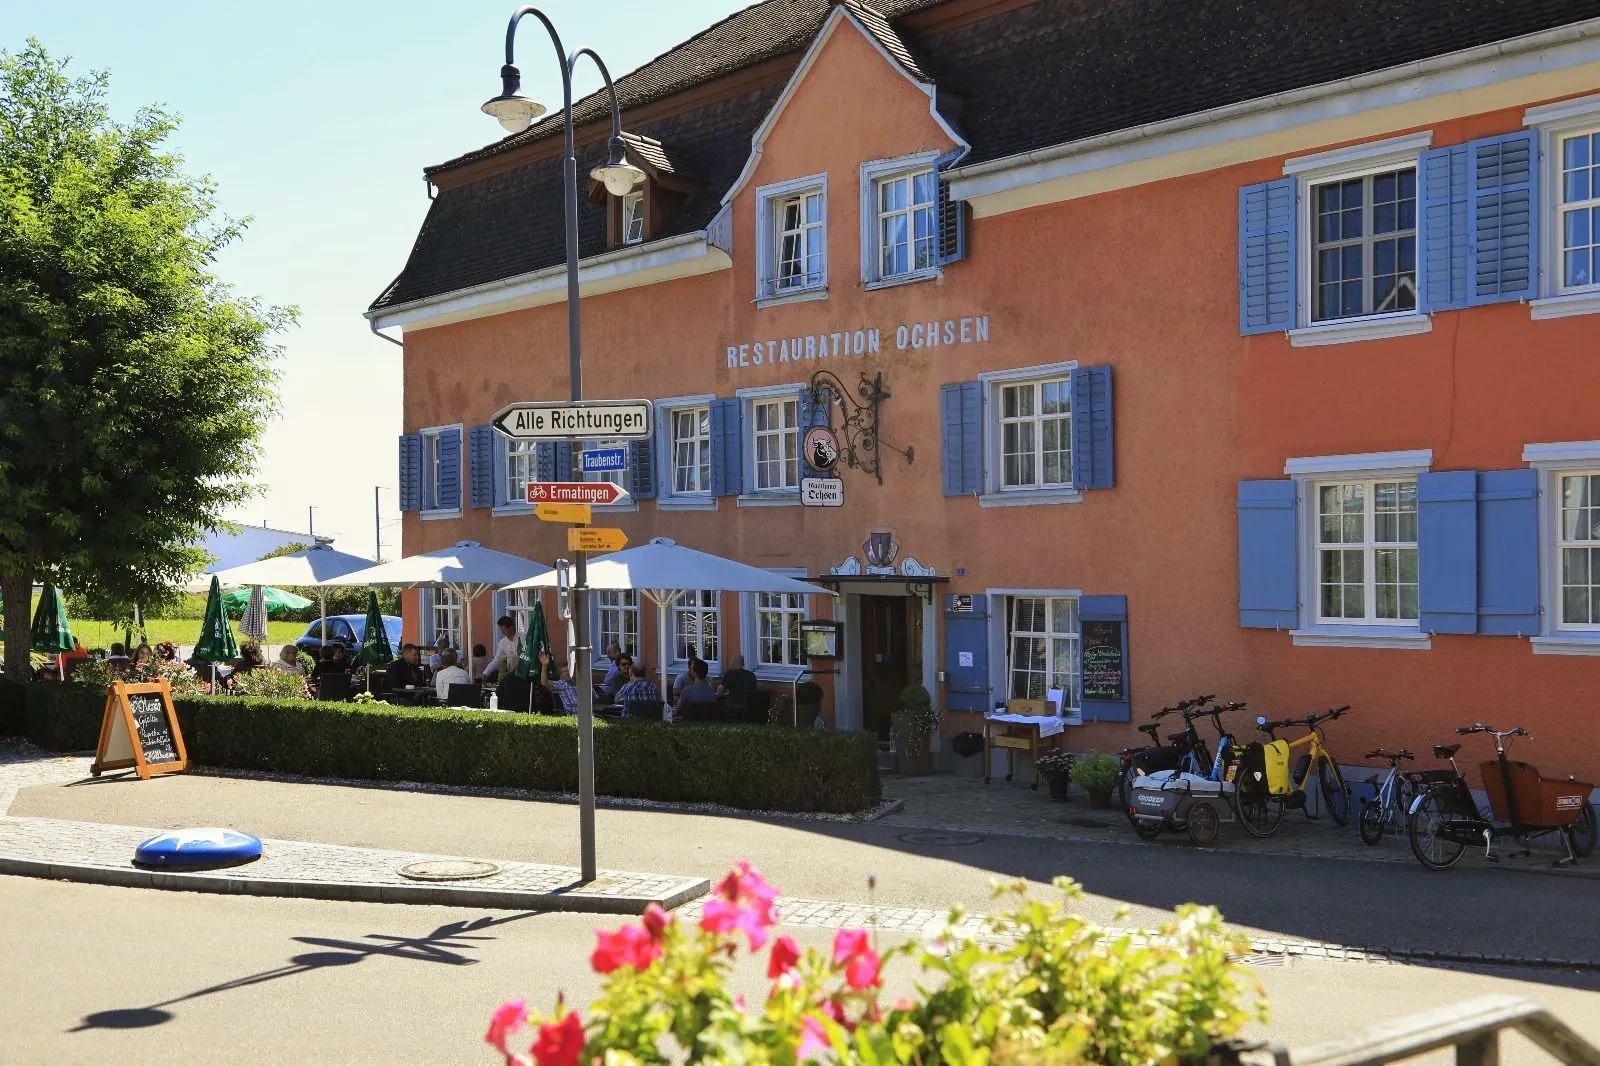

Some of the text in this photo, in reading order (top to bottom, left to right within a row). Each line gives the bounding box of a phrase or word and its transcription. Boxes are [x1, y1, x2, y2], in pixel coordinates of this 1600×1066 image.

[727, 315, 990, 368] RESTAURATION OCHSEN
[515, 410, 643, 432] Alle Richtungen
[584, 452, 624, 468] Traubenstr.
[550, 484, 609, 502] Ermatingen
[808, 490, 837, 500] Ochsen
